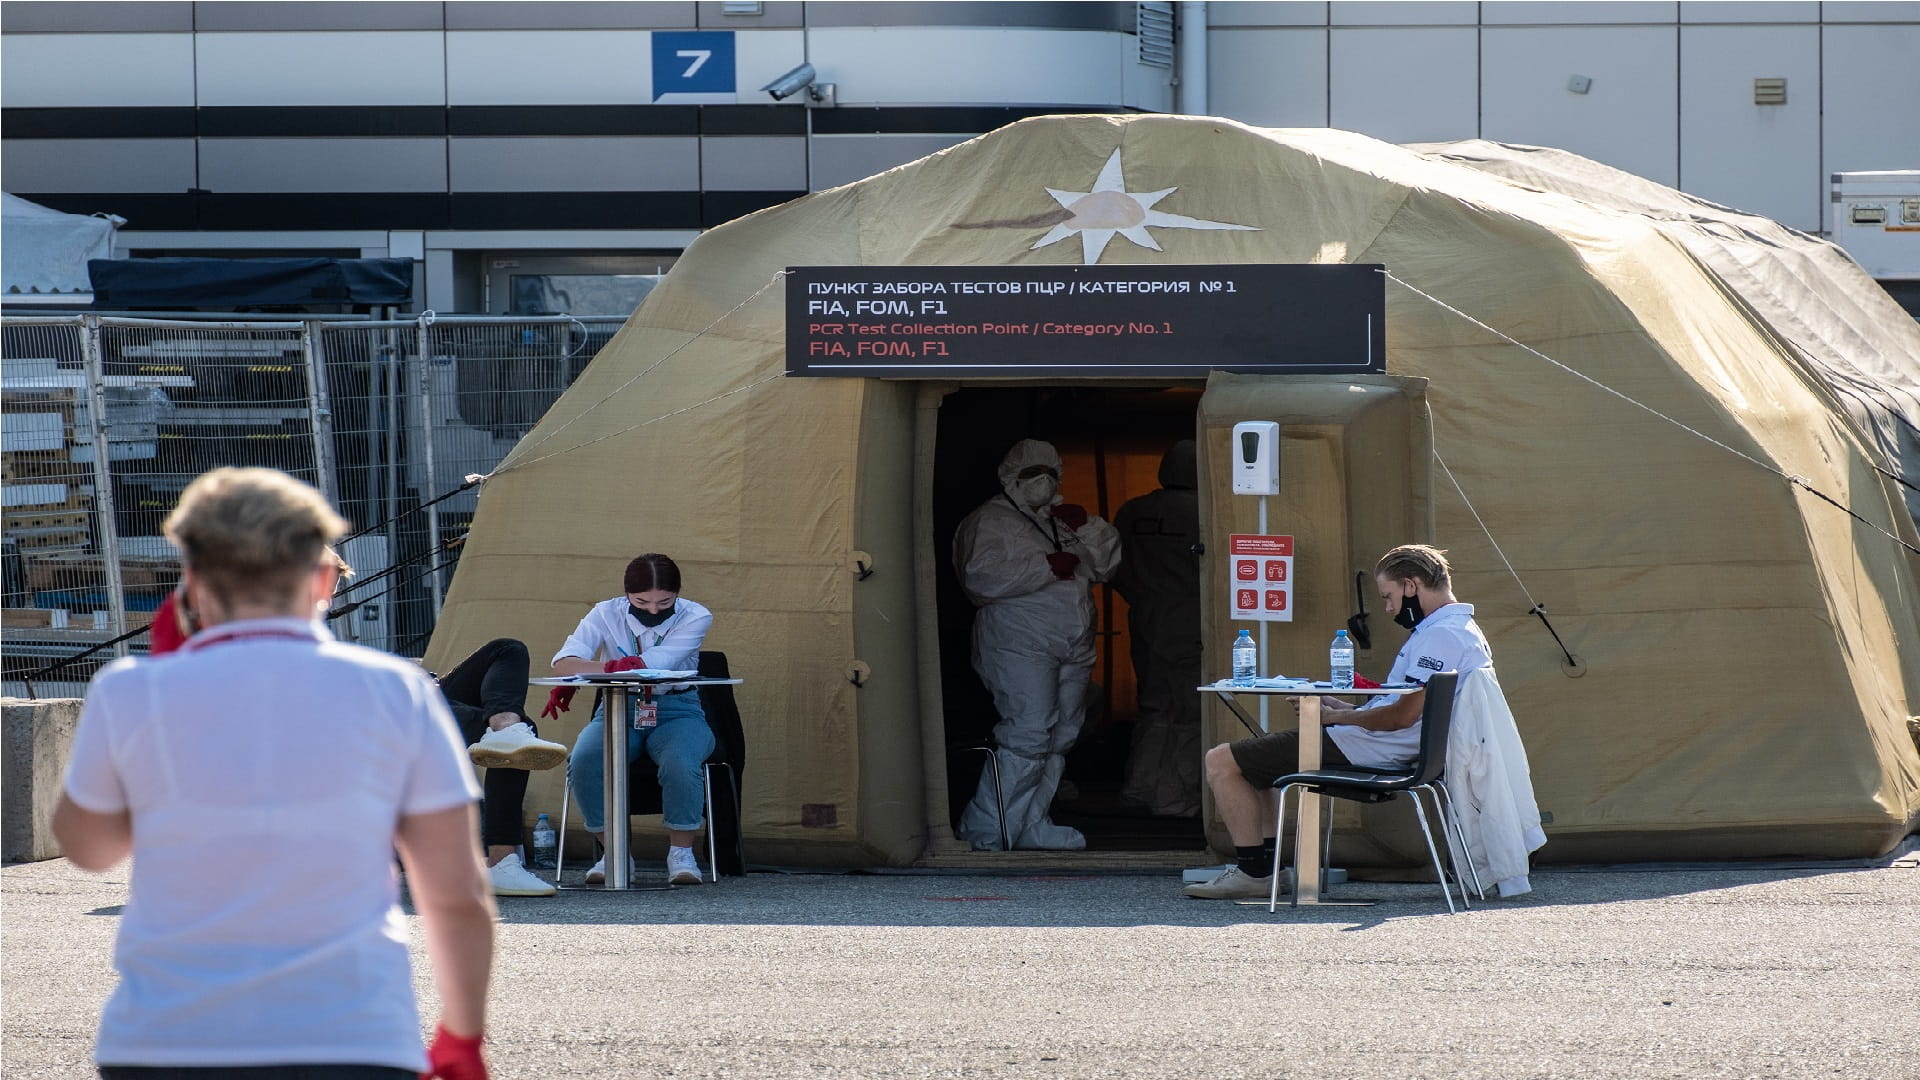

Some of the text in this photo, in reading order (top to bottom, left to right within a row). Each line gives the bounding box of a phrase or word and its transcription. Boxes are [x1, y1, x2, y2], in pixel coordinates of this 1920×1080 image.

[676, 50, 711, 77] 7
[808, 282, 869, 295] ПУНКТ
[872, 282, 947, 295] ЗАБОРА
[949, 281, 1022, 294] ТЕСТОВ
[1026, 281, 1066, 296] ПЦР
[1079, 281, 1190, 294] КАТЕГОРИЯ
[1199, 280, 1223, 293] №
[1226, 280, 1237, 293] 1
[808, 300, 948, 318] FIA, FOM, F1
[809, 323, 844, 335] PCR
[847, 323, 887, 335] Test
[890, 323, 978, 335] Collection
[982, 322, 1029, 335] Point
[1042, 322, 1125, 336] Category
[1128, 322, 1159, 334] No.
[1163, 322, 1173, 334] 1
[810, 341, 949, 358] FIA, FOM, F1
